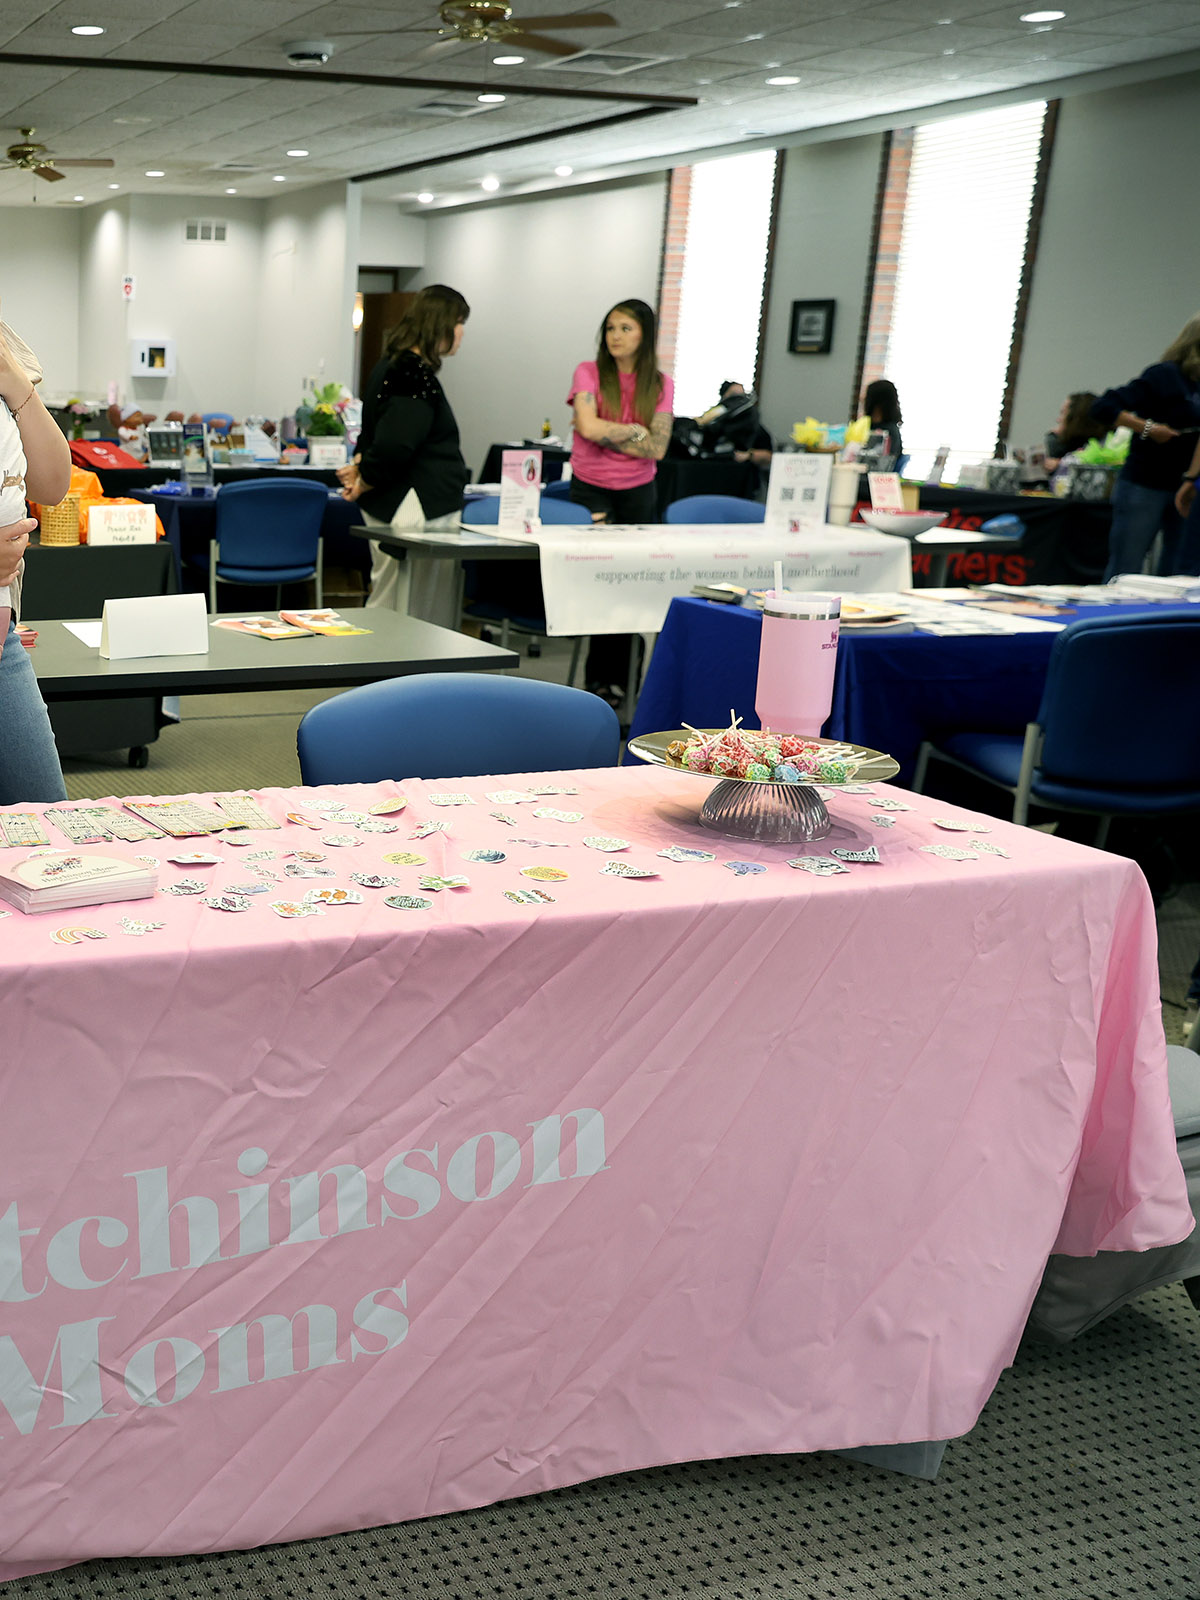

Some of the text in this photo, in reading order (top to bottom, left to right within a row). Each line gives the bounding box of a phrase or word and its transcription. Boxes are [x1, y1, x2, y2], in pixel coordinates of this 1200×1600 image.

[594, 564, 860, 584] supporting the women behin motherhood
